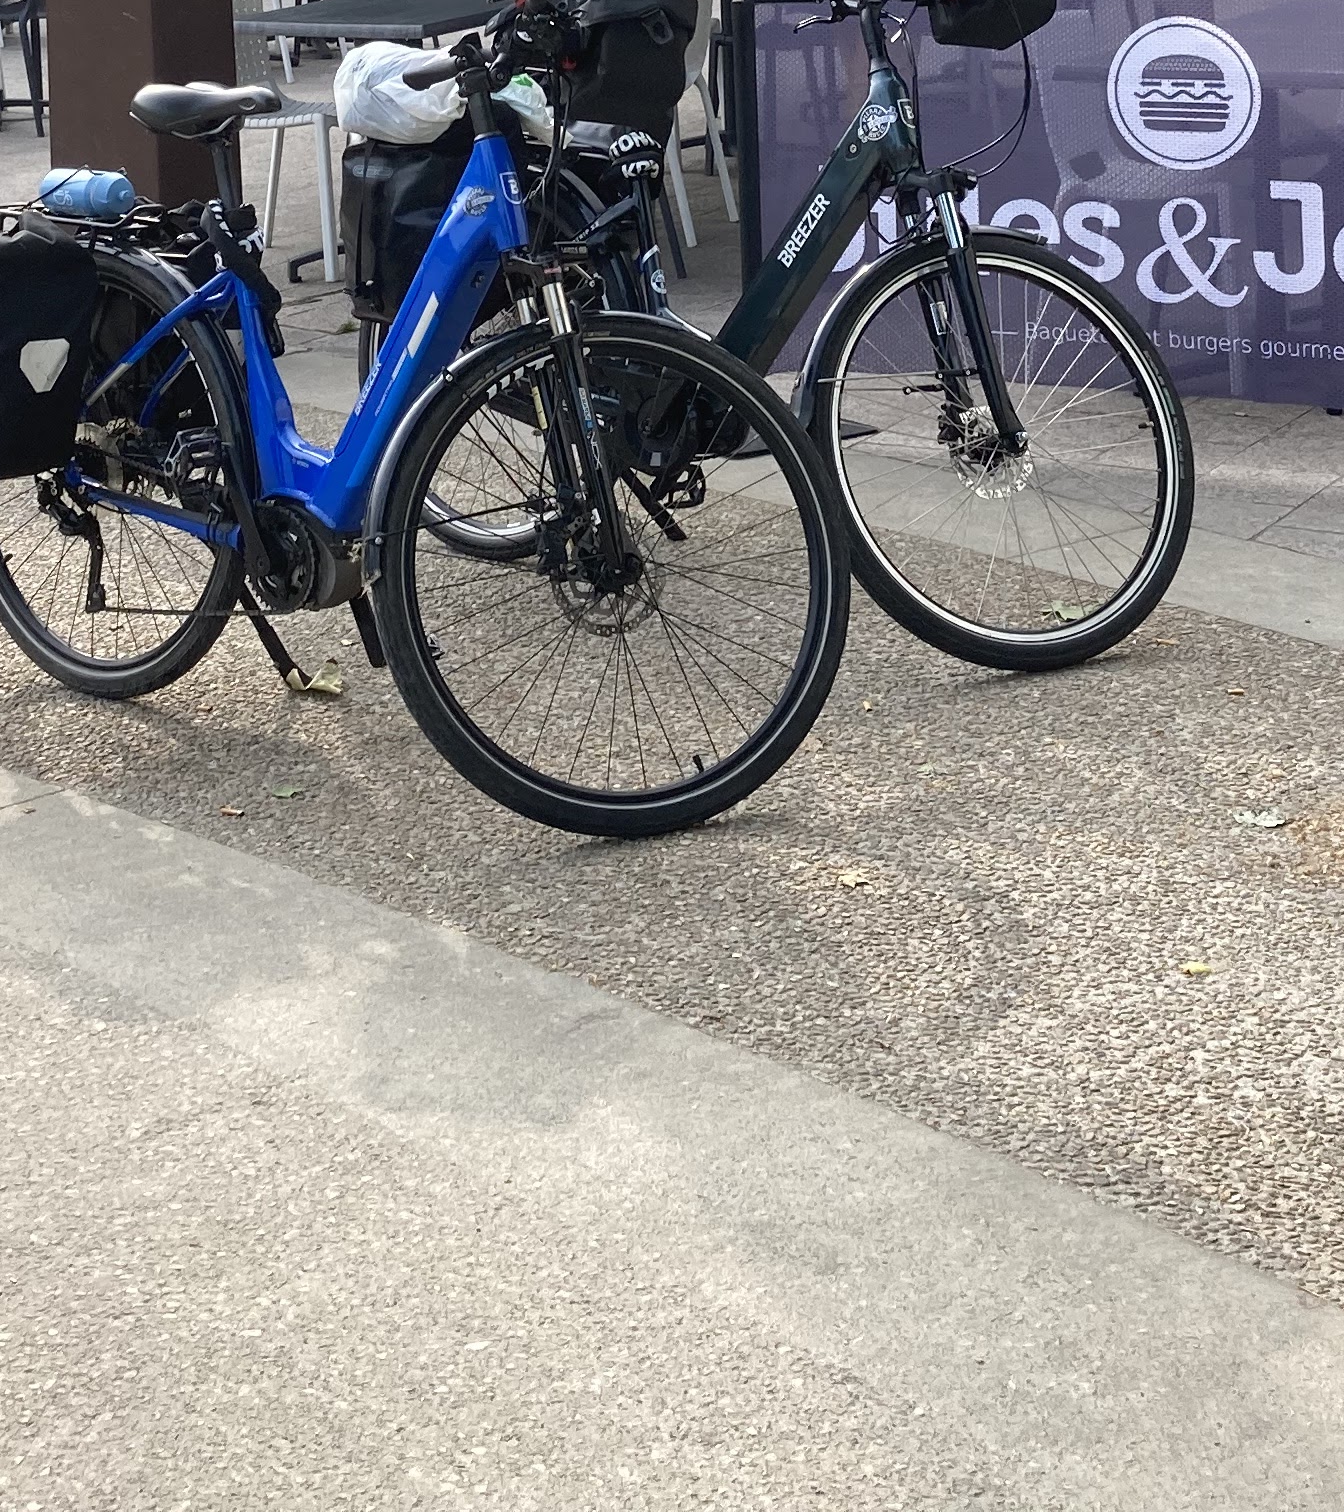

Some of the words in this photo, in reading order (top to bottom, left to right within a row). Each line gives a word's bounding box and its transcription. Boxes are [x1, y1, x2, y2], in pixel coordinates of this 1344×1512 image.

[777, 193, 831, 268] BREEZER
[1135, 196, 1249, 308] &
[1168, 329, 1253, 355] burgers
